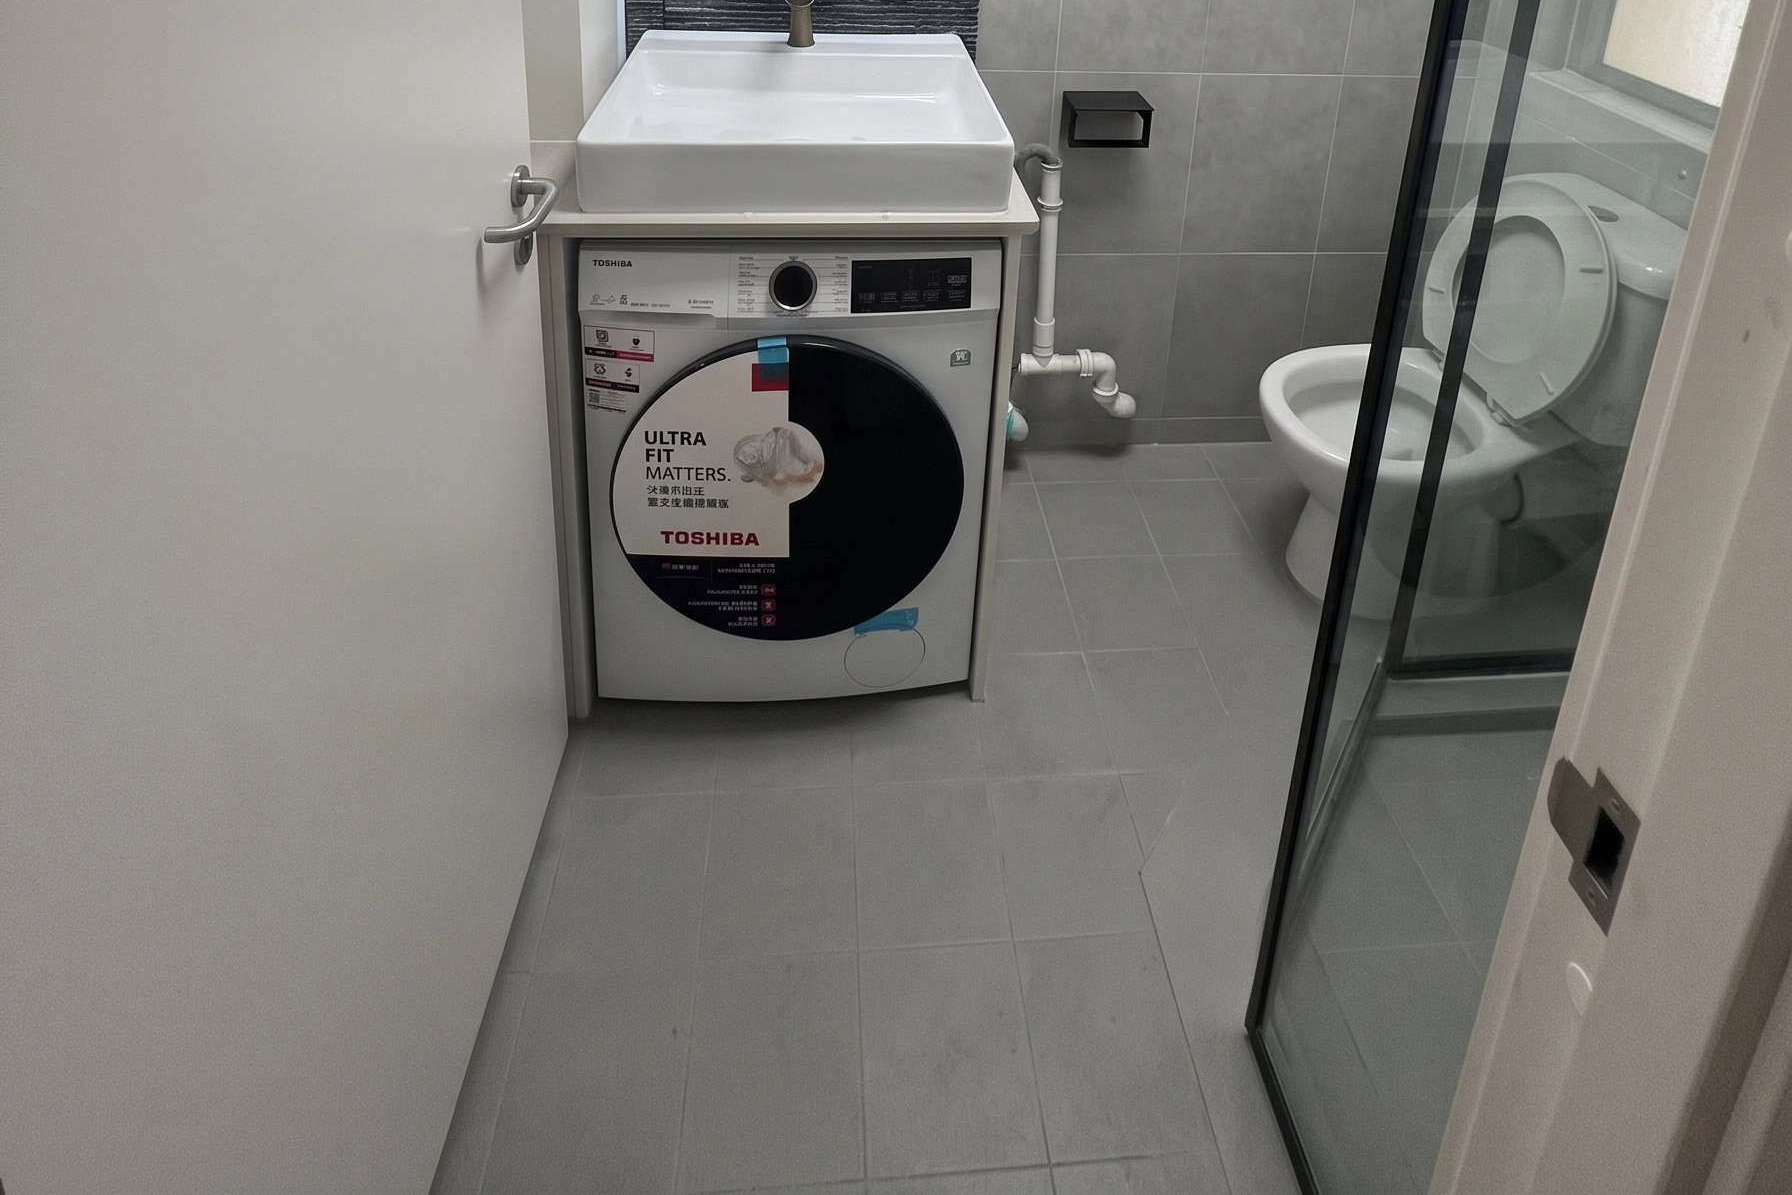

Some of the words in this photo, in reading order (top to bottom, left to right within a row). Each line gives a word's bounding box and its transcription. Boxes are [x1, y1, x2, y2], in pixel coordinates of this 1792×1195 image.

[592, 259, 633, 268] TOSHIBA
[644, 430, 707, 446] ULTRA
[645, 448, 675, 463] FIT
[646, 466, 732, 482] MATTERS.
[660, 530, 760, 546] TOSHIBA
